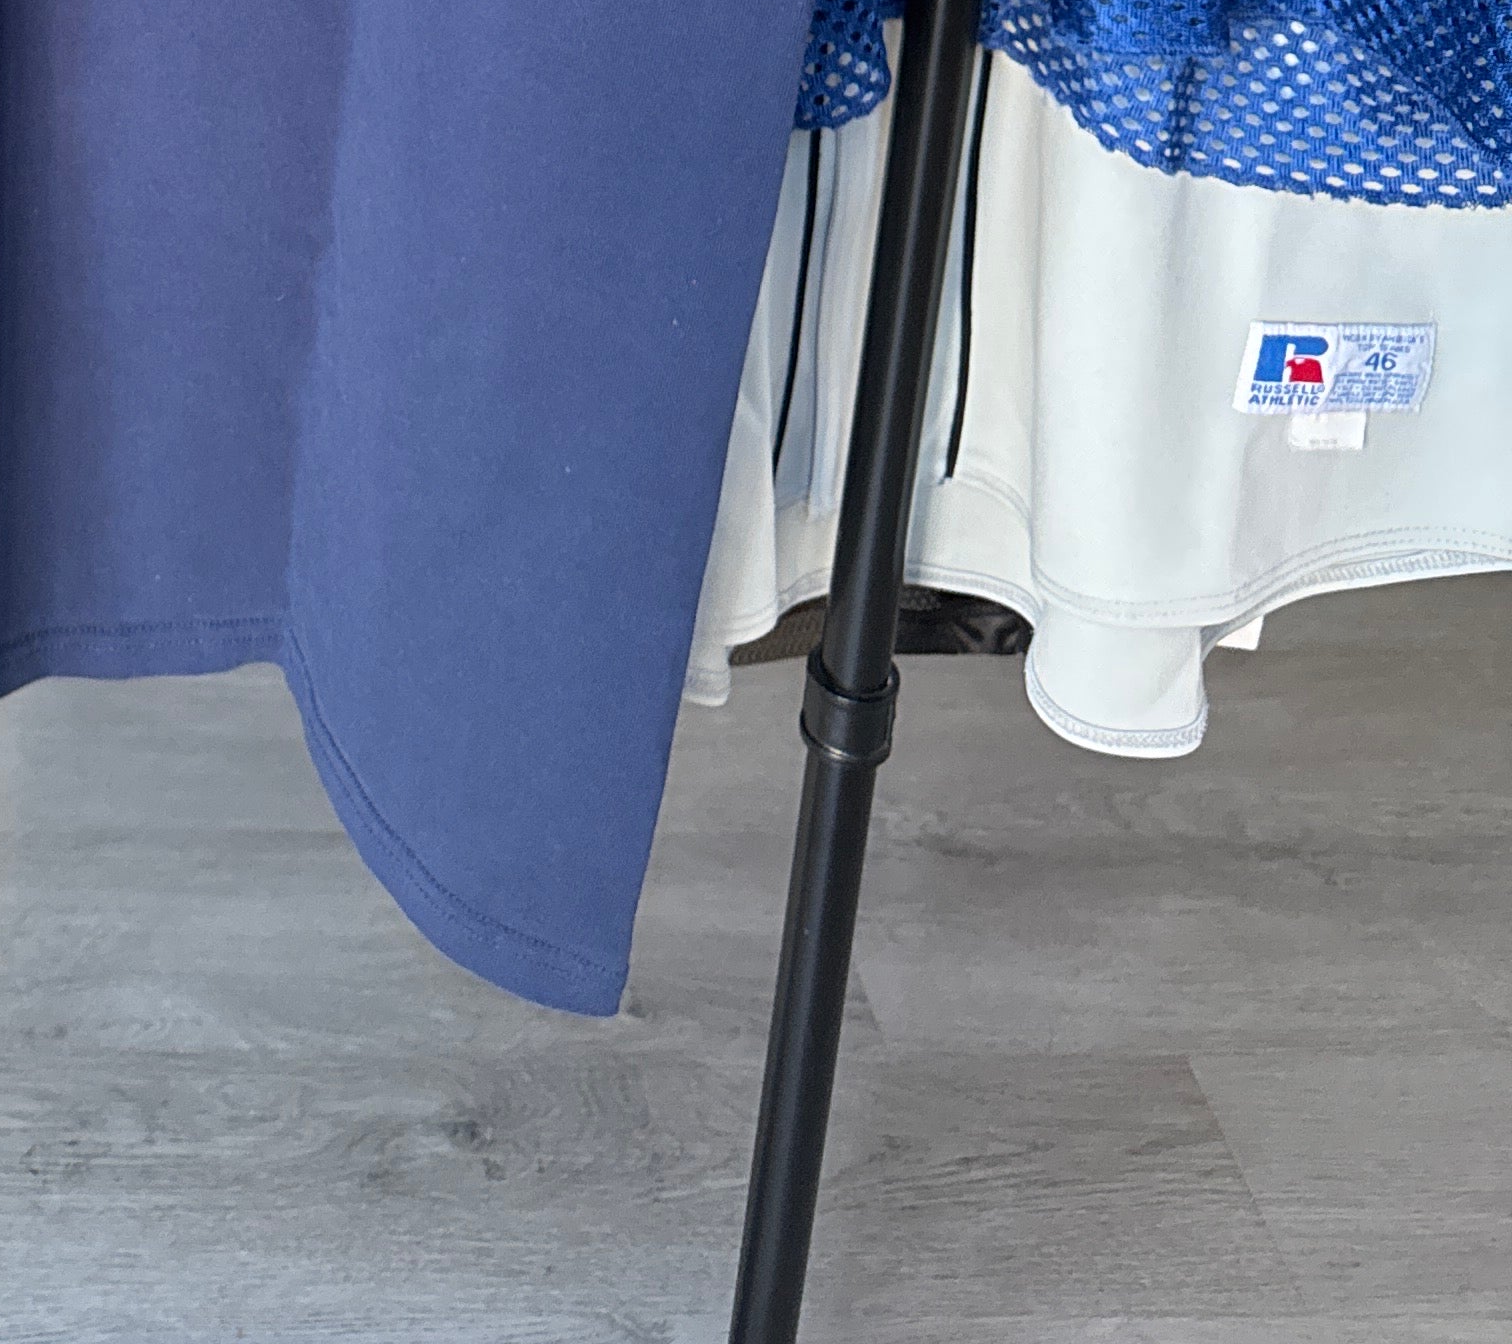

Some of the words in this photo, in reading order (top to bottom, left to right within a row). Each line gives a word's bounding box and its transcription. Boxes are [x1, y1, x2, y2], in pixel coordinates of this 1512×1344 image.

[1364, 352, 1398, 372] 46
[1251, 383, 1318, 395] RUSSELL
[1248, 393, 1320, 406] ATHLETIC
